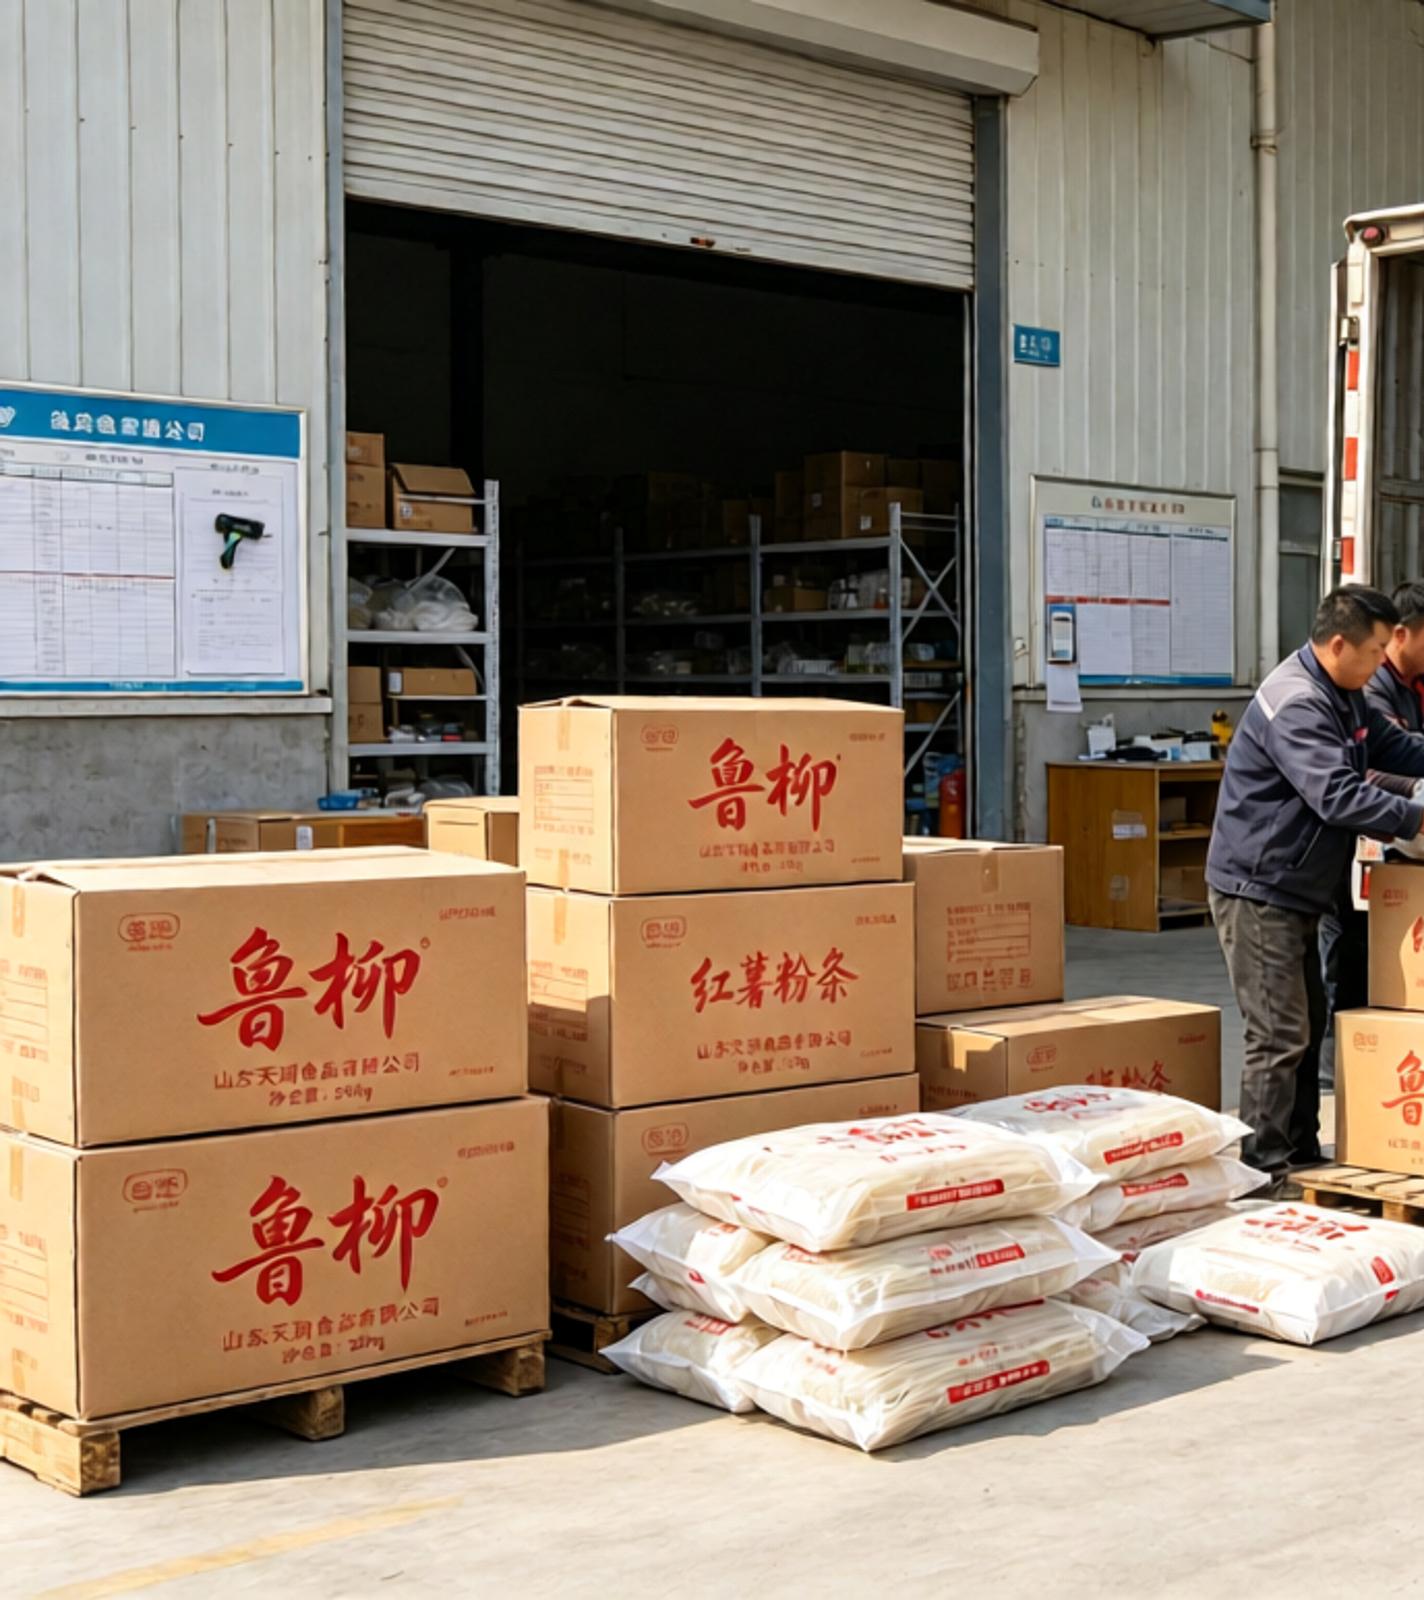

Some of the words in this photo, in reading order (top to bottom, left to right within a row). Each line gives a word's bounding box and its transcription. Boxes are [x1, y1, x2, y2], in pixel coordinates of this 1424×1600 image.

[688, 737, 838, 832] 鲁柳
[197, 926, 421, 1051] 鲁柳
[690, 947, 859, 1013] 红薯粉条
[211, 1175, 440, 1305] 鲁柳
